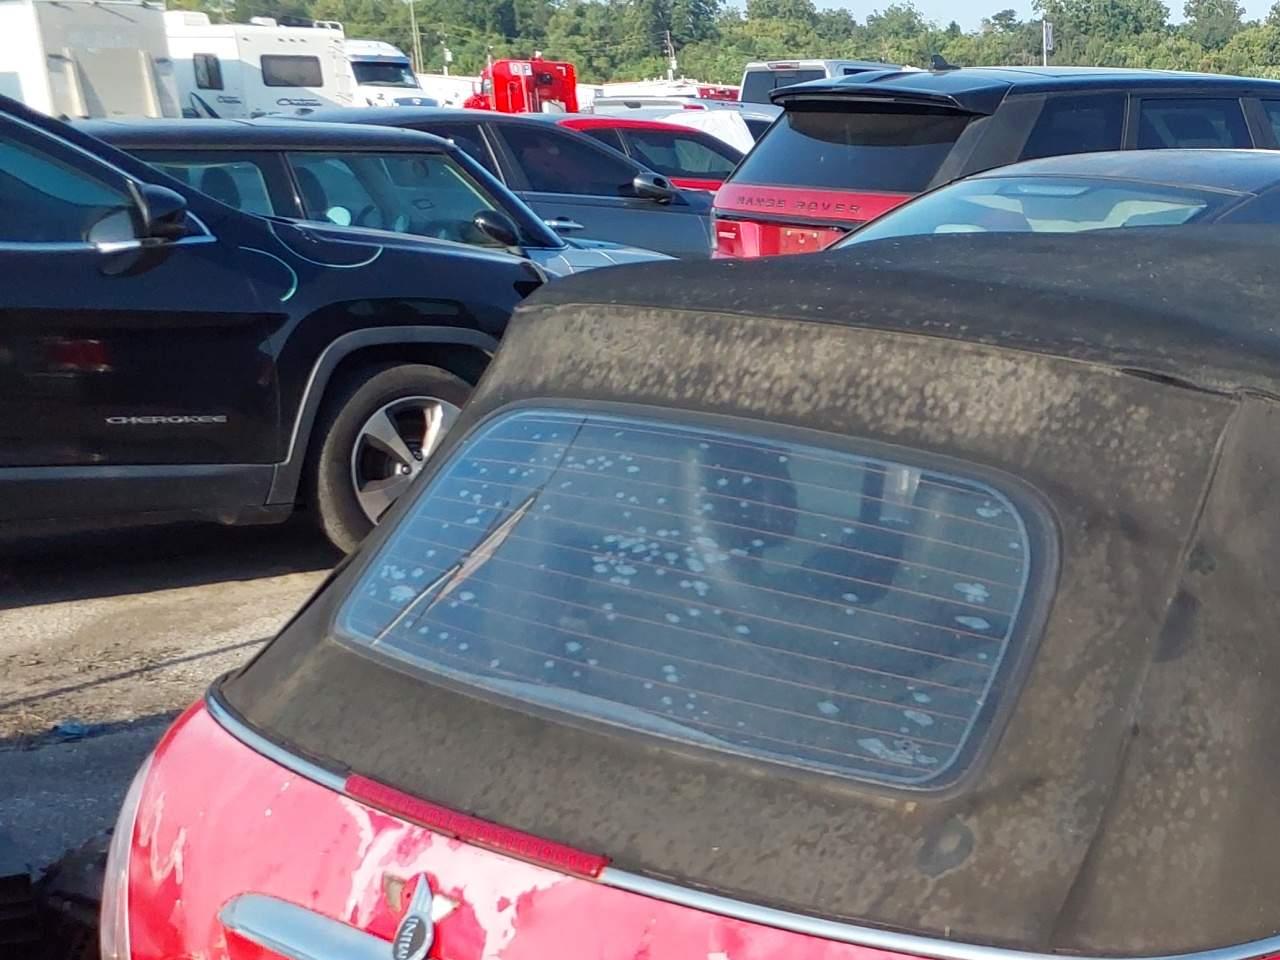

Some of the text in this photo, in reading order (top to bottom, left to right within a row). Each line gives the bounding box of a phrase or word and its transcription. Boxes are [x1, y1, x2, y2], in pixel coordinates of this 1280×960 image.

[736, 196, 861, 213] RANGE ROVER
[105, 416, 227, 424] CHEROKEE
[397, 918, 419, 959] MINI
